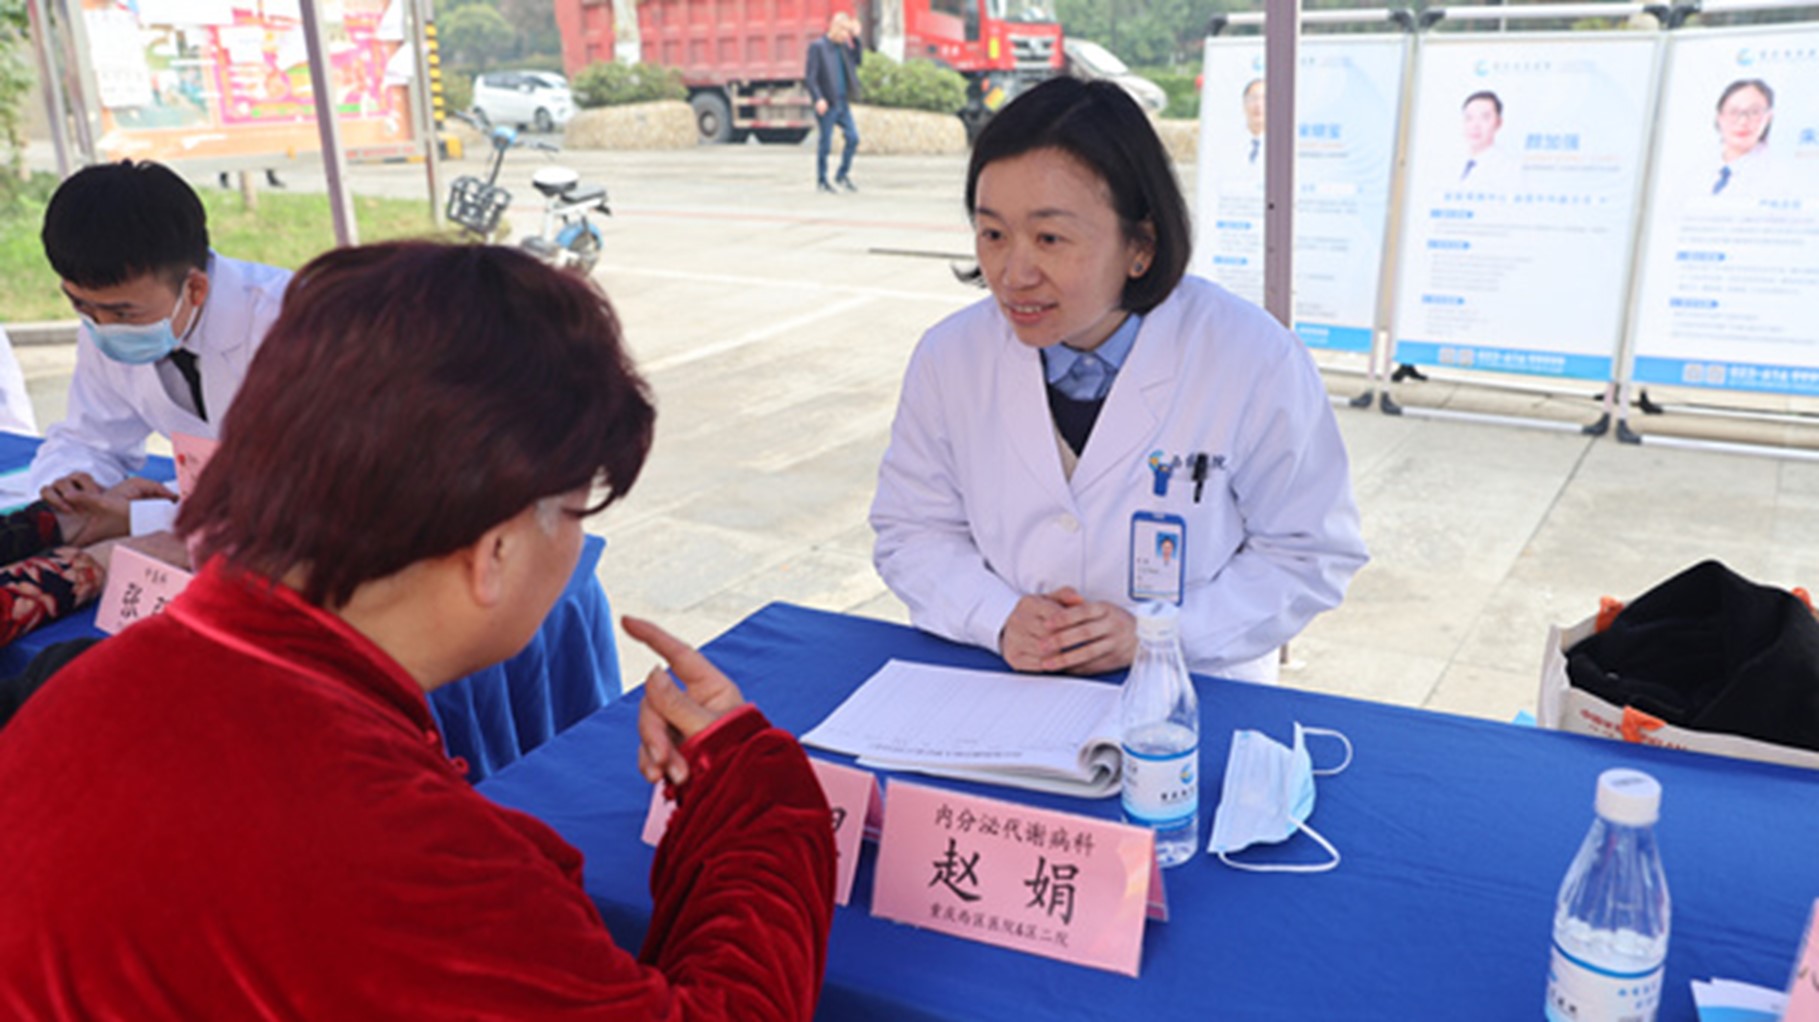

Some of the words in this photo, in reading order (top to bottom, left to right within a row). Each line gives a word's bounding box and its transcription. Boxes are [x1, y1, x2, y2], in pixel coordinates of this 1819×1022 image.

[935, 803, 1095, 857] 内分泌代谢病科
